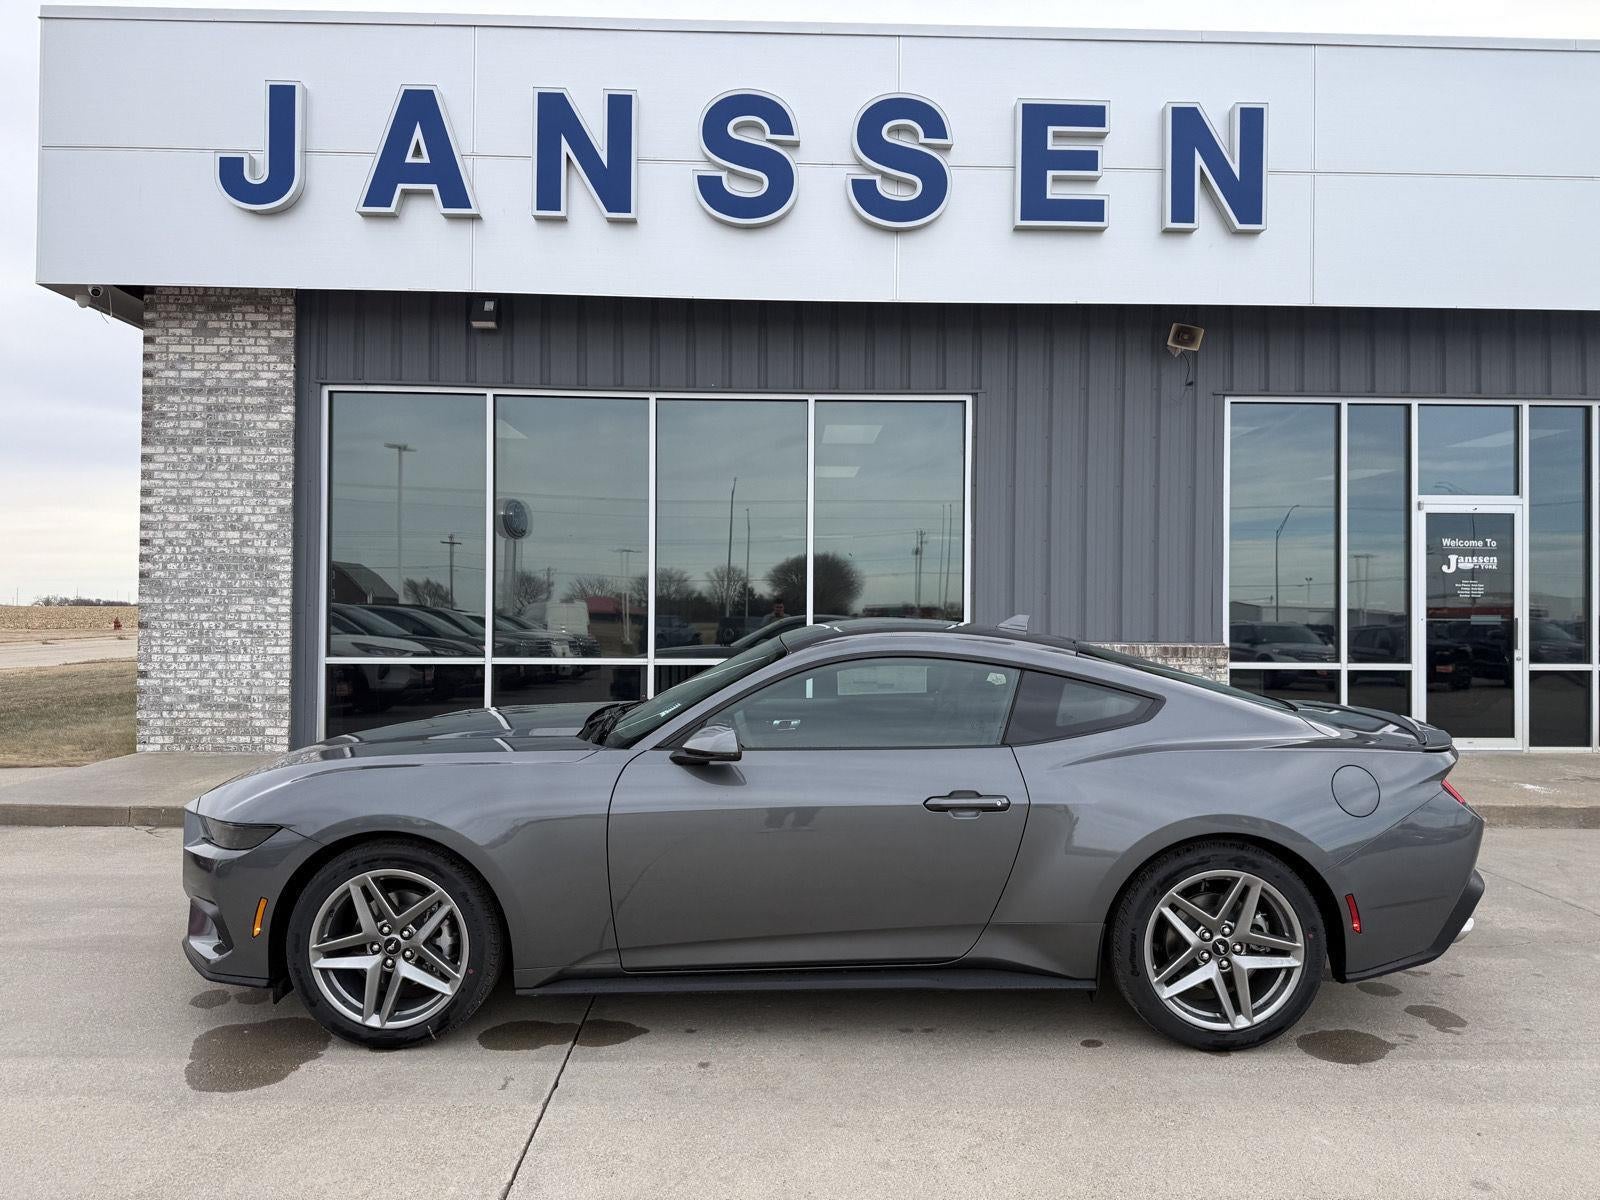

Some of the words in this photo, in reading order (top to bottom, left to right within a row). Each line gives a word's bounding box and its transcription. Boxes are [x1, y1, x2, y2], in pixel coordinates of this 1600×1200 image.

[215, 80, 1269, 234] JANSSEN
[1442, 538, 1483, 547] Welcome
[1485, 538, 1497, 547] To
[1441, 554, 1498, 574] Janssen
